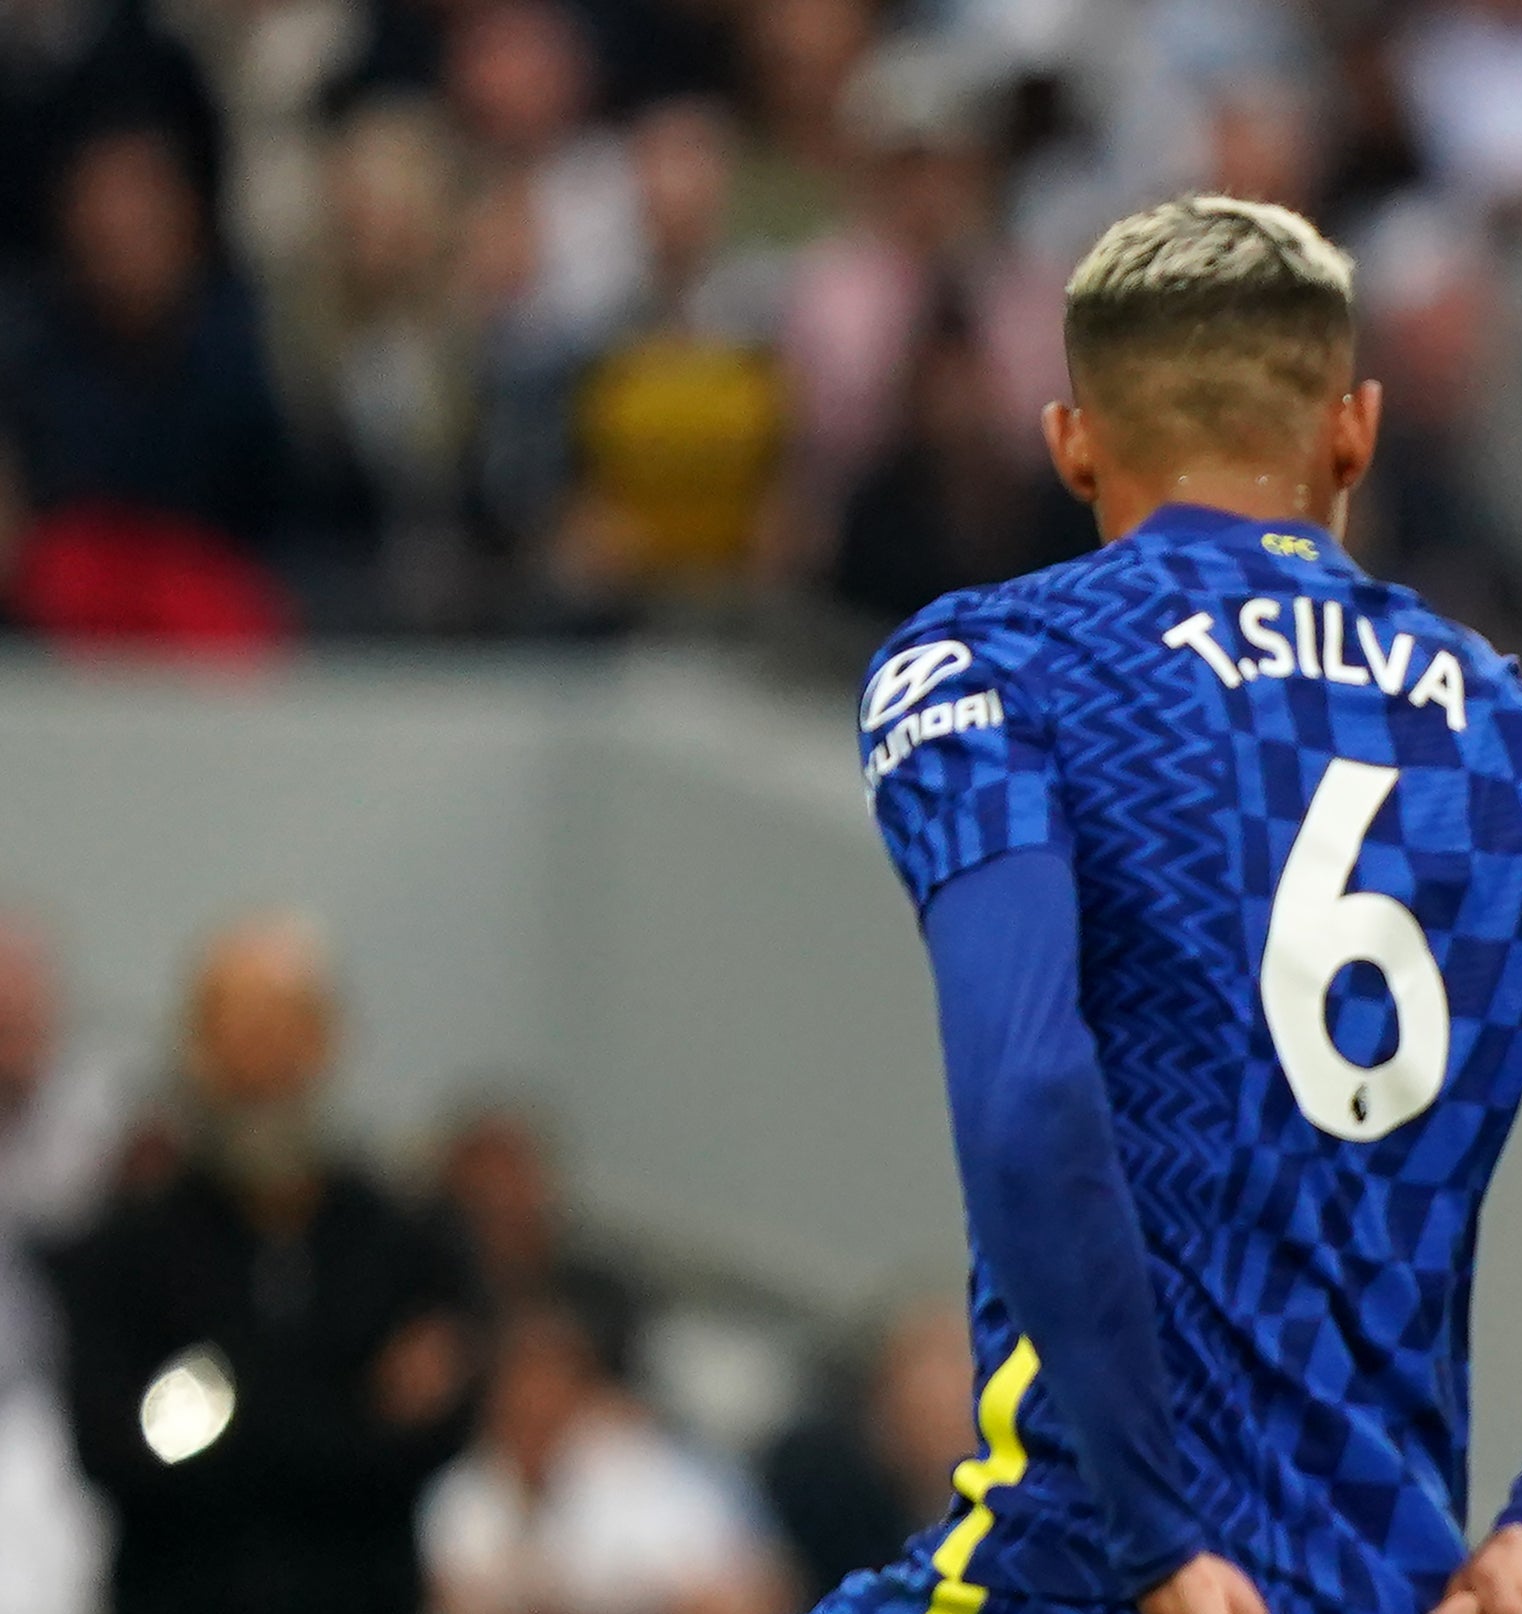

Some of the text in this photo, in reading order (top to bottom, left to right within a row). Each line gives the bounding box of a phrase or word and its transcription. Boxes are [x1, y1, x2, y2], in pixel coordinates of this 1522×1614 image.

[1261, 533, 1320, 562] CFC
[1163, 597, 1466, 733] T.SILVA
[1260, 757, 1449, 1143] 6
